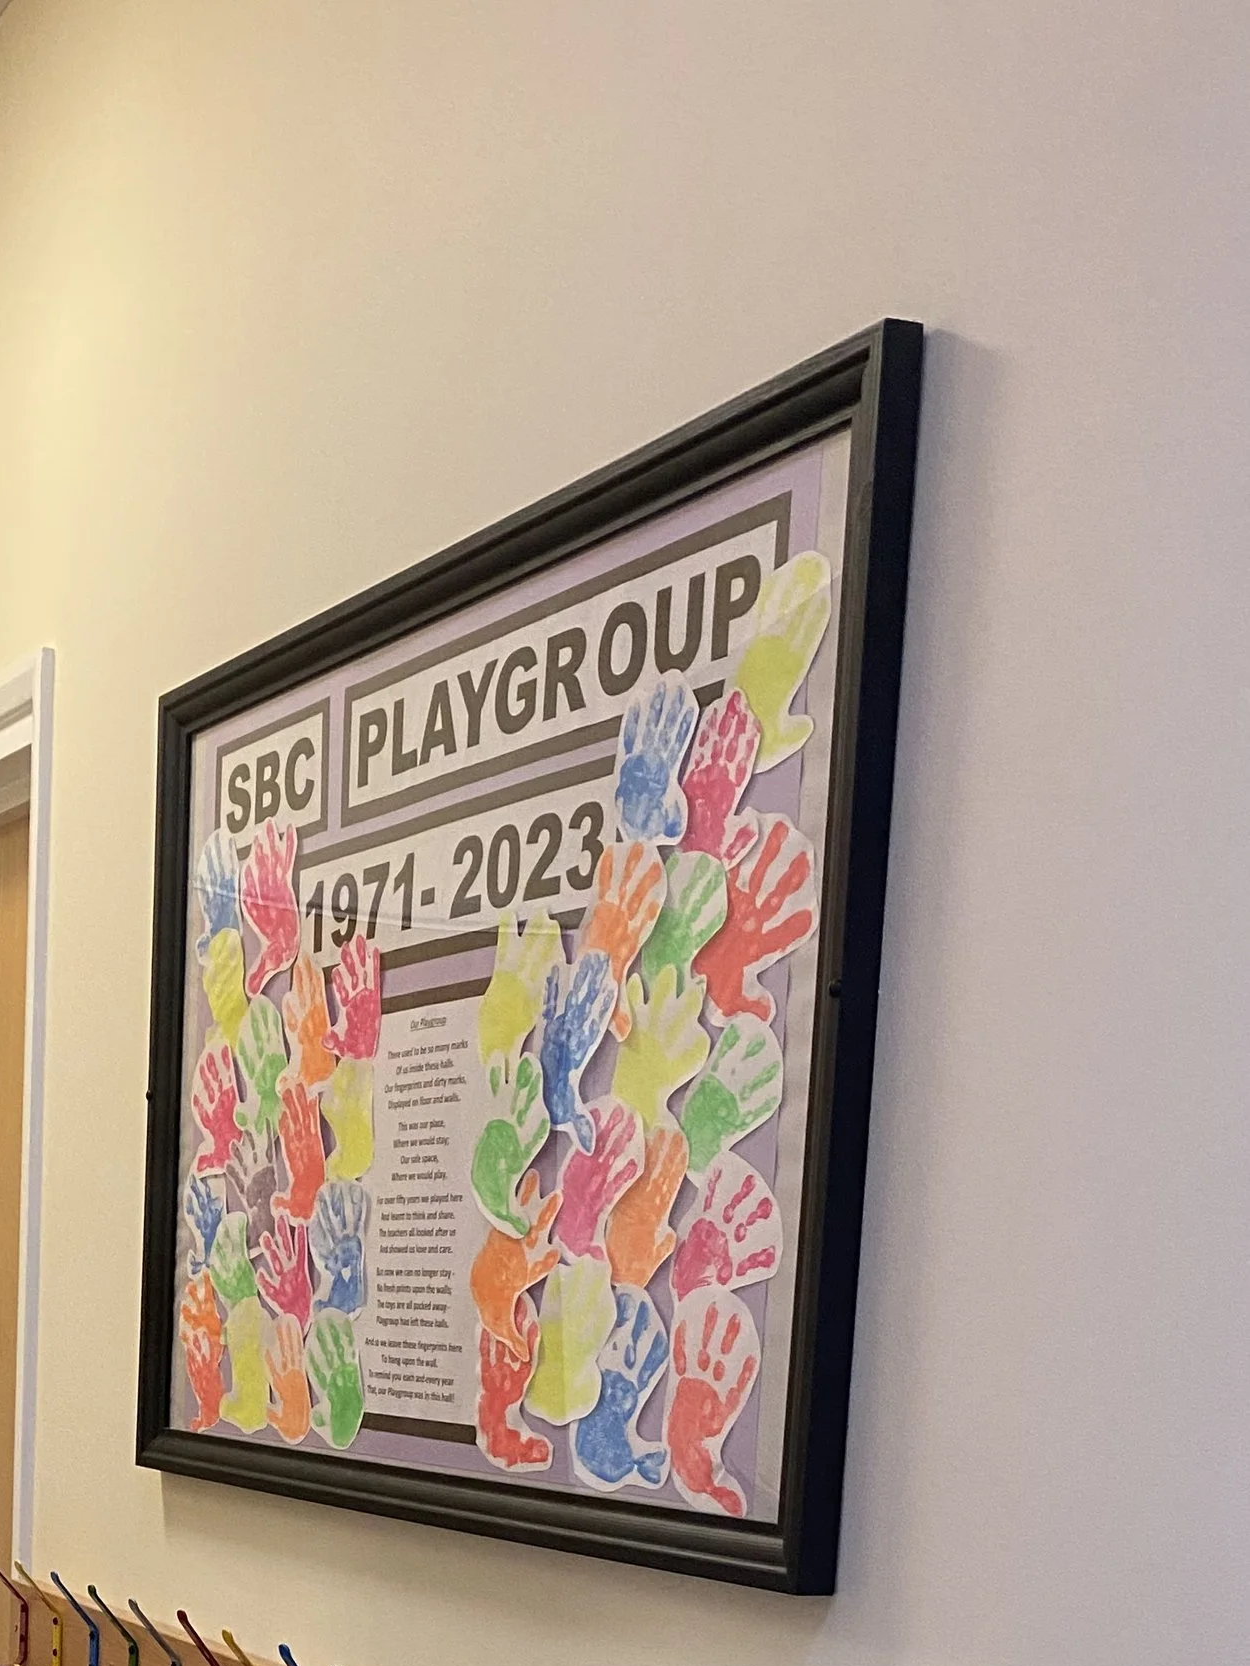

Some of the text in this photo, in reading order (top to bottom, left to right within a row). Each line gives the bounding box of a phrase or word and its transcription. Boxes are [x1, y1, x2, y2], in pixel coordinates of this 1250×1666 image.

[227, 555, 762, 834] SBC PLAYGROUP
[449, 801, 605, 919] 2023
